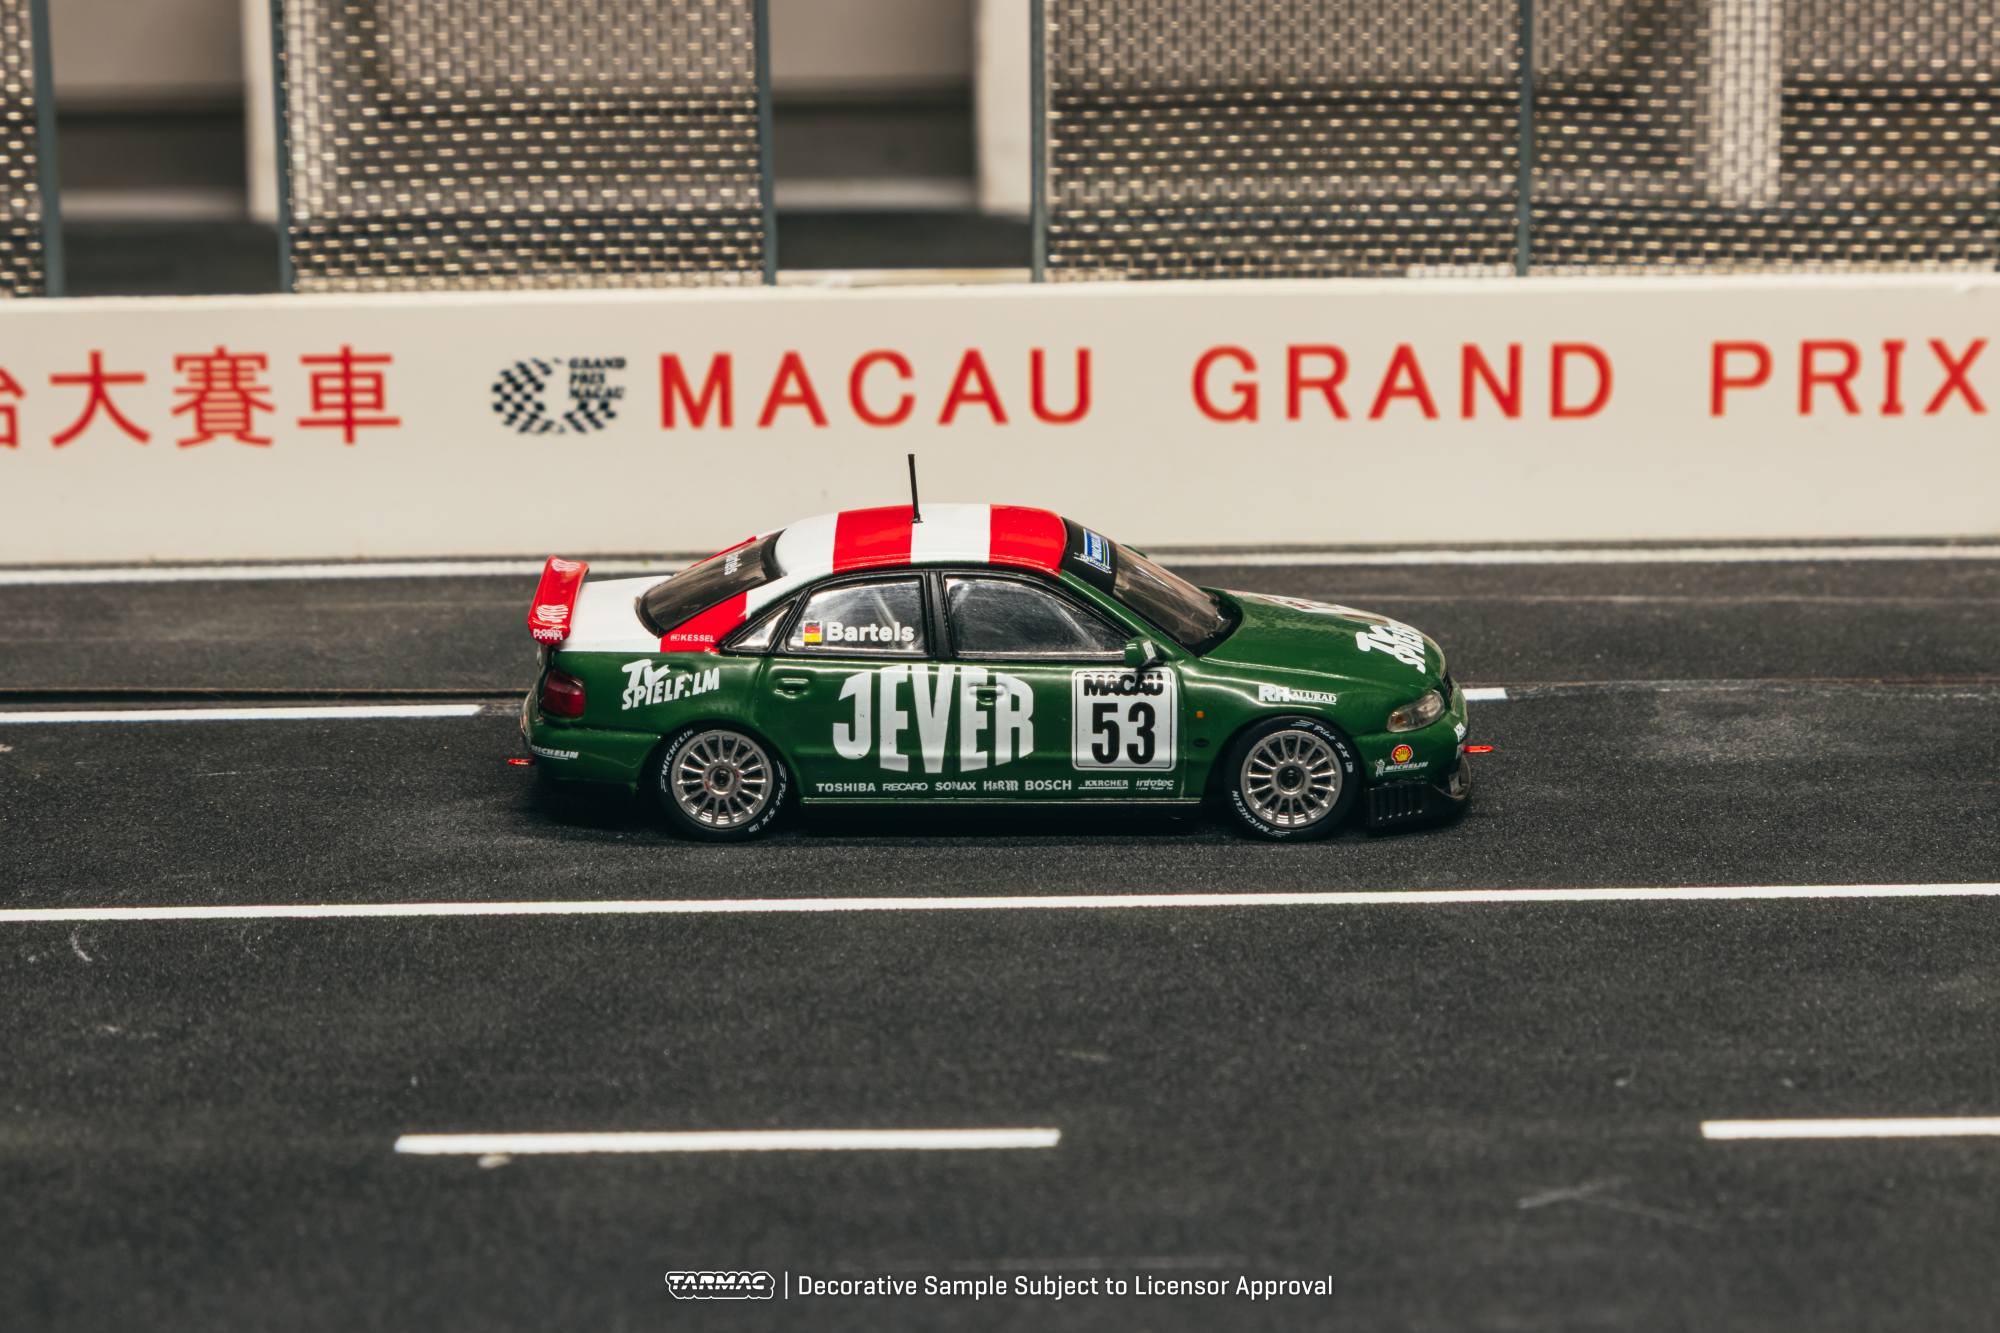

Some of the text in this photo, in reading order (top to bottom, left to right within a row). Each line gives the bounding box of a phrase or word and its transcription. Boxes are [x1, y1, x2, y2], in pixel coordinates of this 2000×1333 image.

[660, 337, 1990, 430] MACAU GRAND PRIX
[681, 633, 716, 643] KESSEL
[827, 621, 915, 642] Bartels
[621, 659, 671, 692] TV
[1083, 673, 1165, 697] MACAU
[832, 663, 1035, 774] JEVER
[1091, 701, 1156, 765] 53
[661, 729, 694, 777] MICHELIN
[816, 782, 877, 793] TOSHIBA
[882, 782, 929, 792] RECARO
[935, 781, 977, 792] SONAX
[1025, 779, 1072, 791] BOSCH
[1231, 790, 1270, 832] MICHELIN
